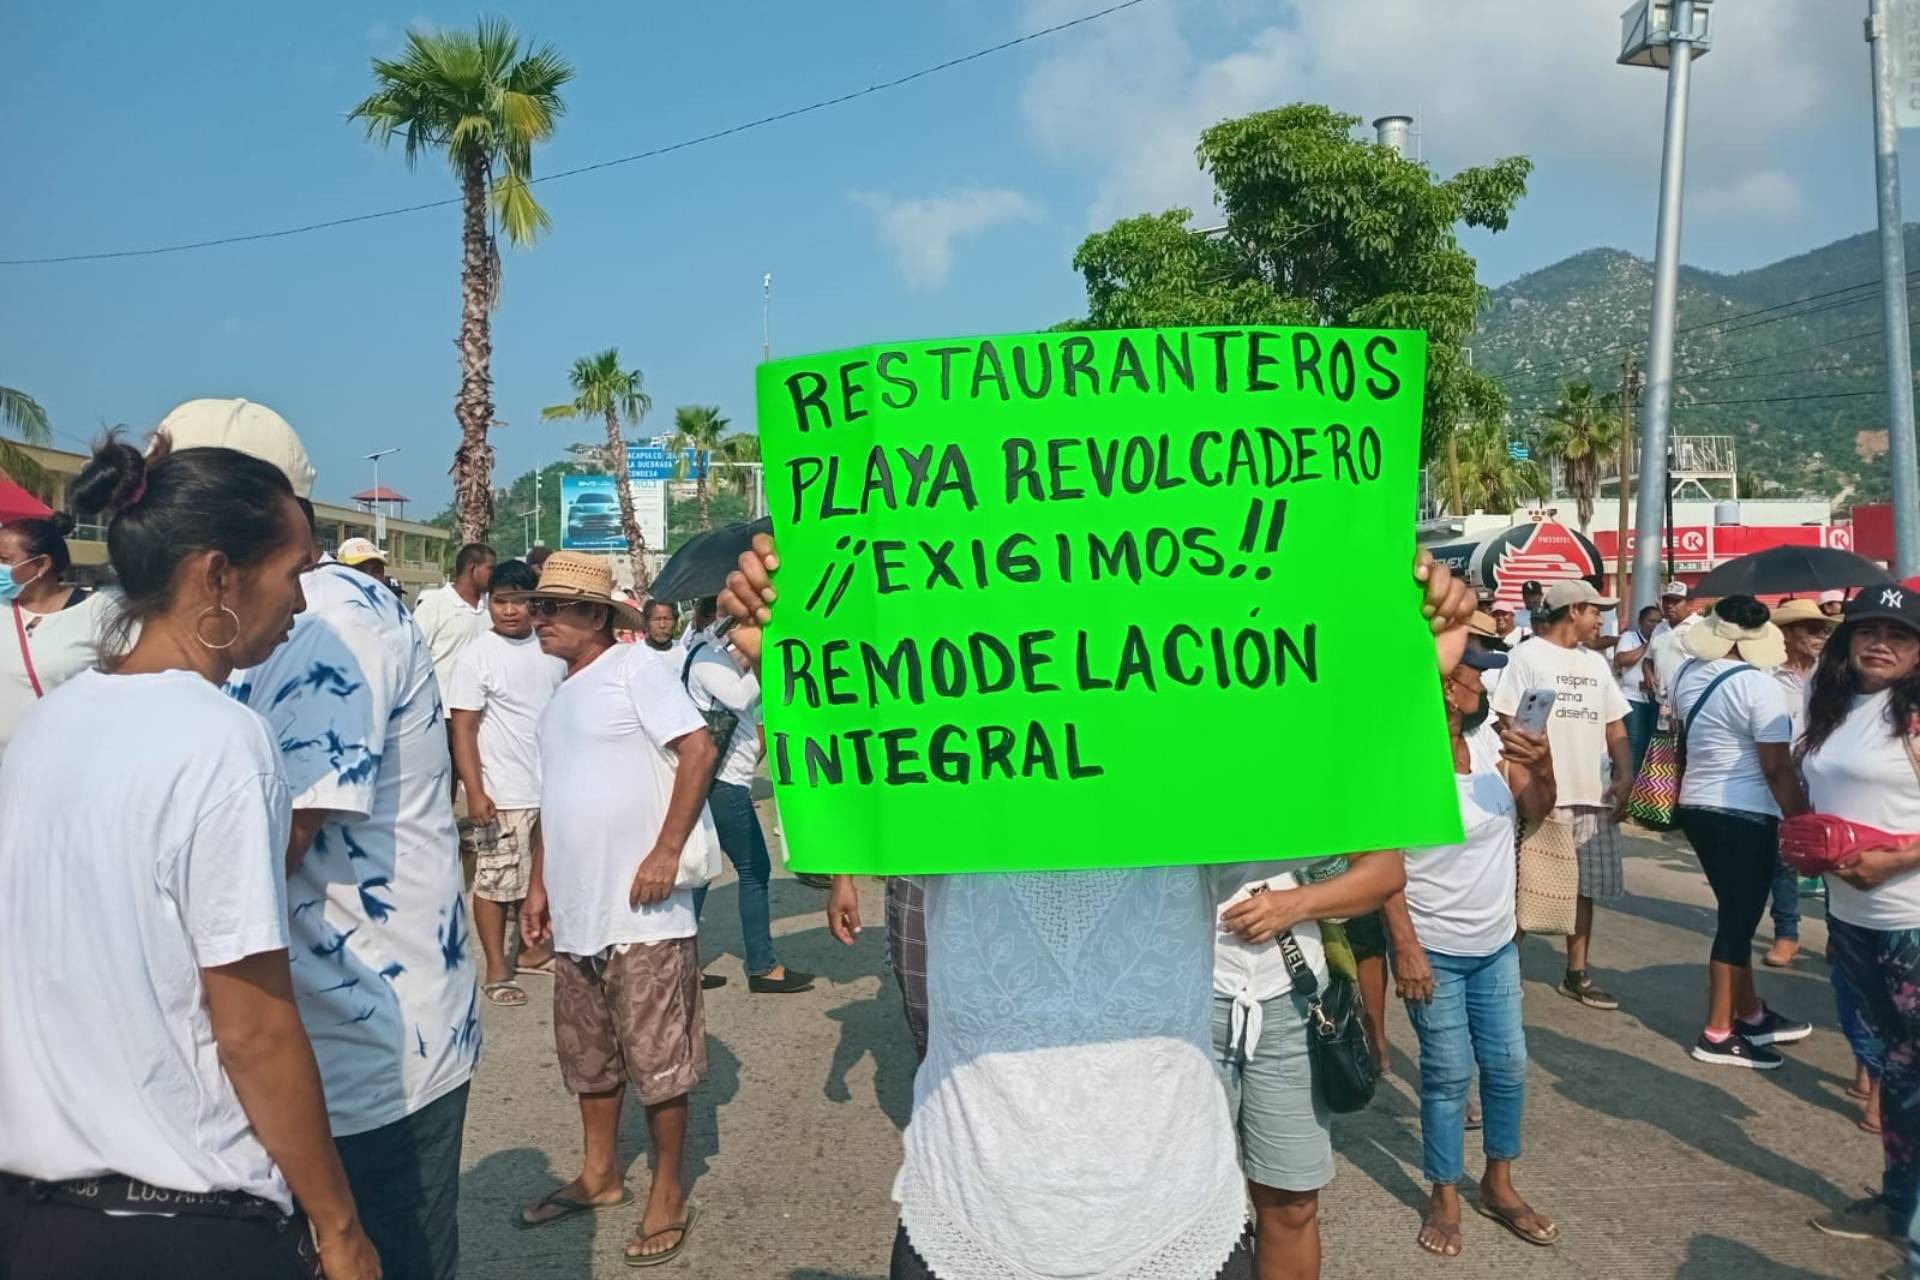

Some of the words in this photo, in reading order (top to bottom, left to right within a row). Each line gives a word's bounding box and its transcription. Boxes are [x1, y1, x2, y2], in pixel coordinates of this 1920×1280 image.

[784, 335, 1401, 433] RESTAURANTEROS
[785, 443, 978, 524] PLAYA
[1002, 423, 1382, 504] REVOLCADERO
[1880, 588, 1904, 609] NY
[774, 608, 1318, 709] REMODELACIÓN
[1556, 691, 1583, 702] ama
[1557, 675, 1598, 690] respira
[1555, 707, 1599, 721] diseña
[773, 720, 1104, 787] INTEGRAL
